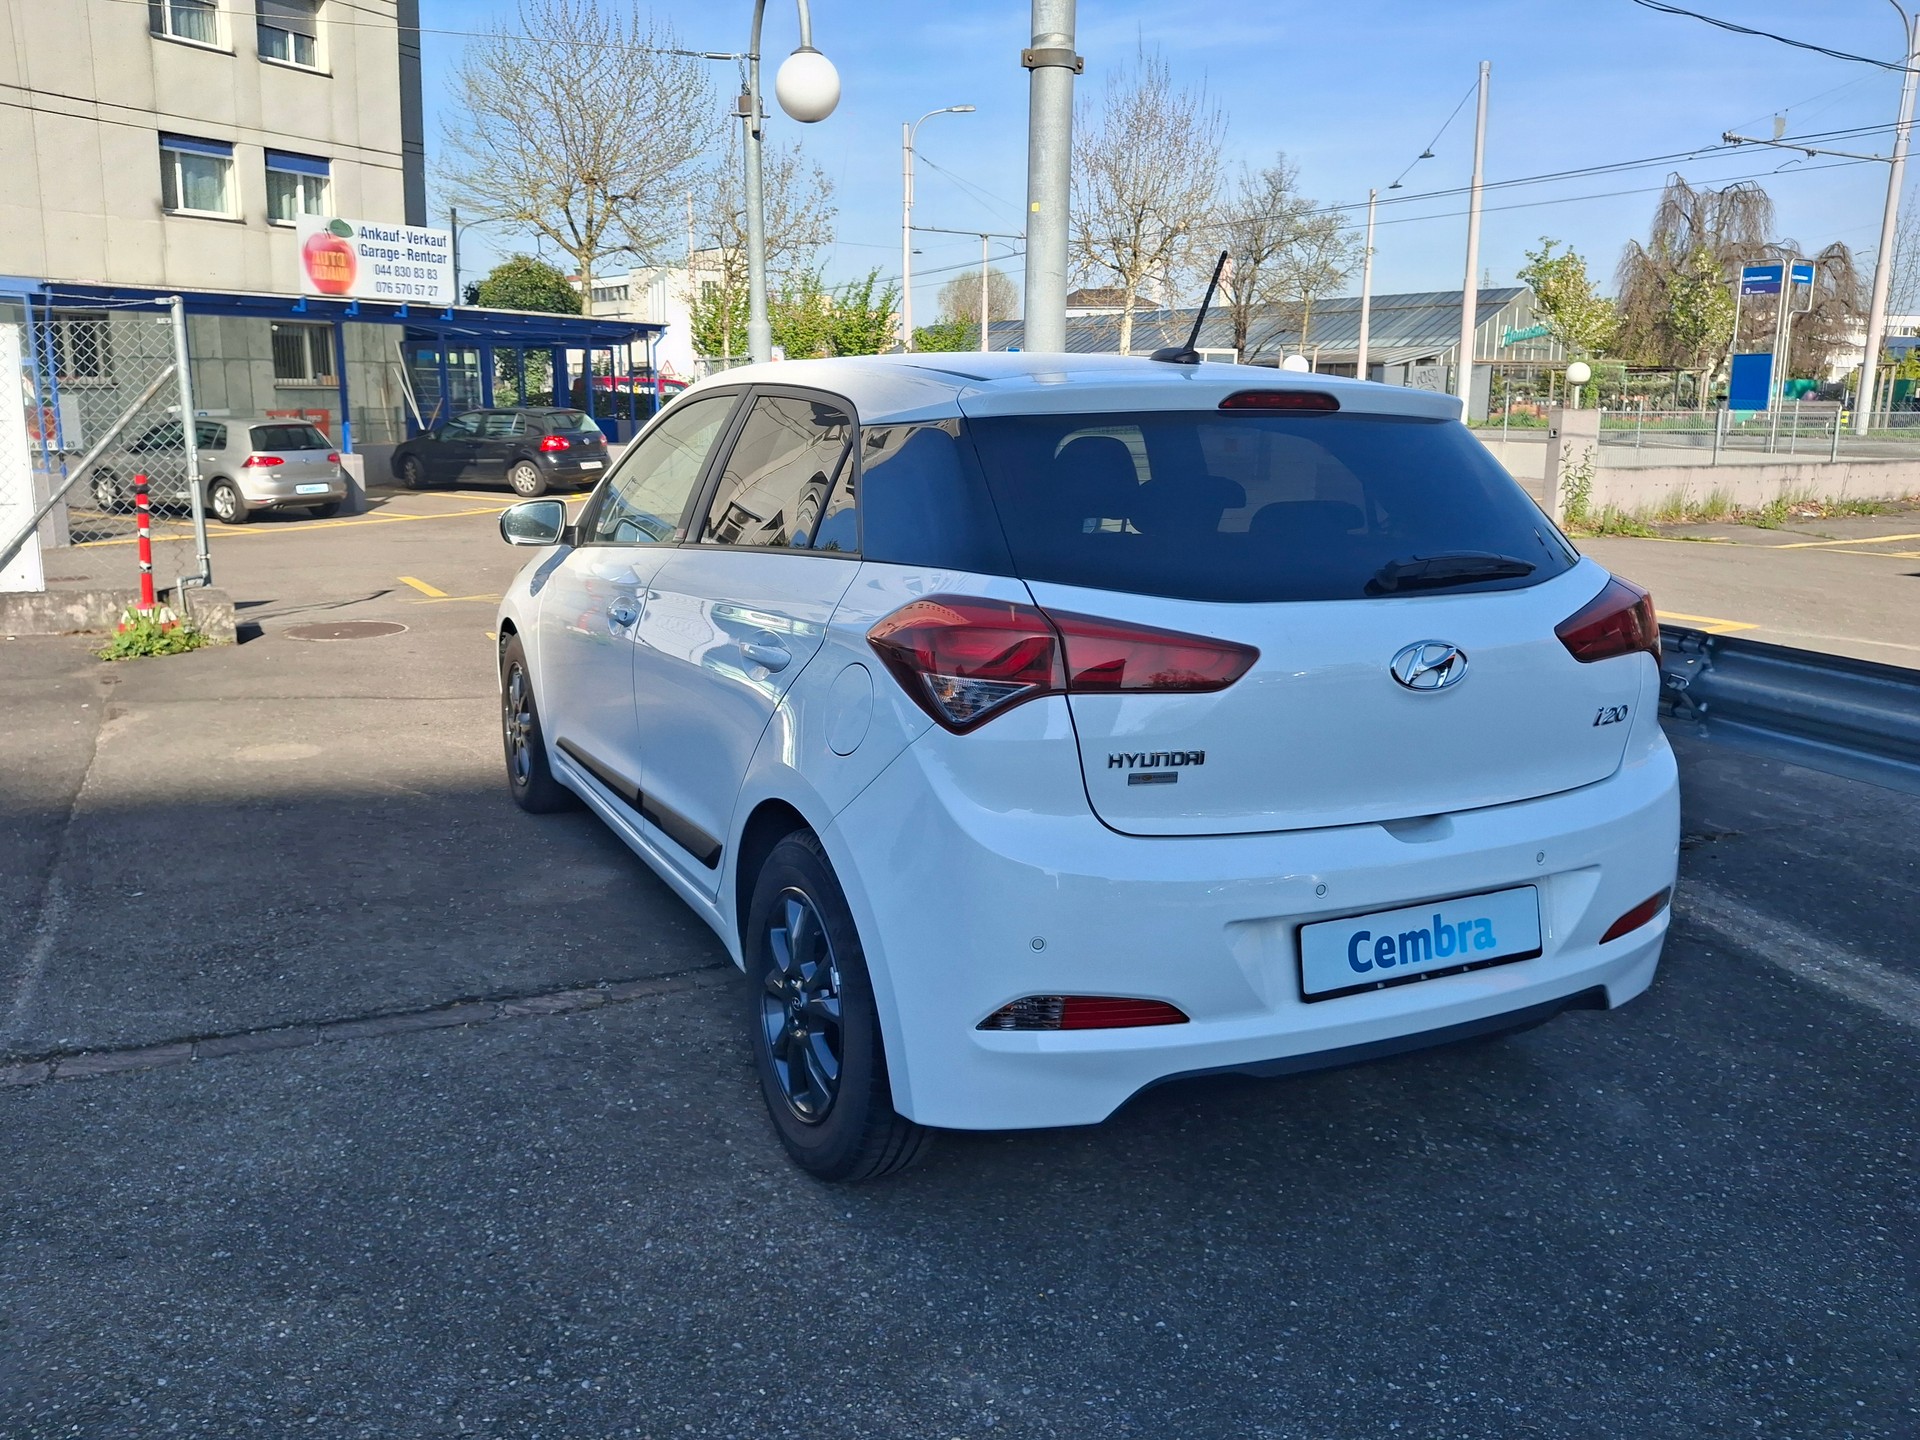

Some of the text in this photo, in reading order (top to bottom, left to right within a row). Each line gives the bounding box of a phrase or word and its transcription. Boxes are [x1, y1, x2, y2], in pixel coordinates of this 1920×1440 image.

[375, 264, 438, 280] 044 830 83 83
[376, 281, 439, 297] 076 570 57 27
[1592, 704, 1628, 727] i20
[1108, 750, 1205, 769] HYUNDAI
[1347, 913, 1496, 974] Cembra
